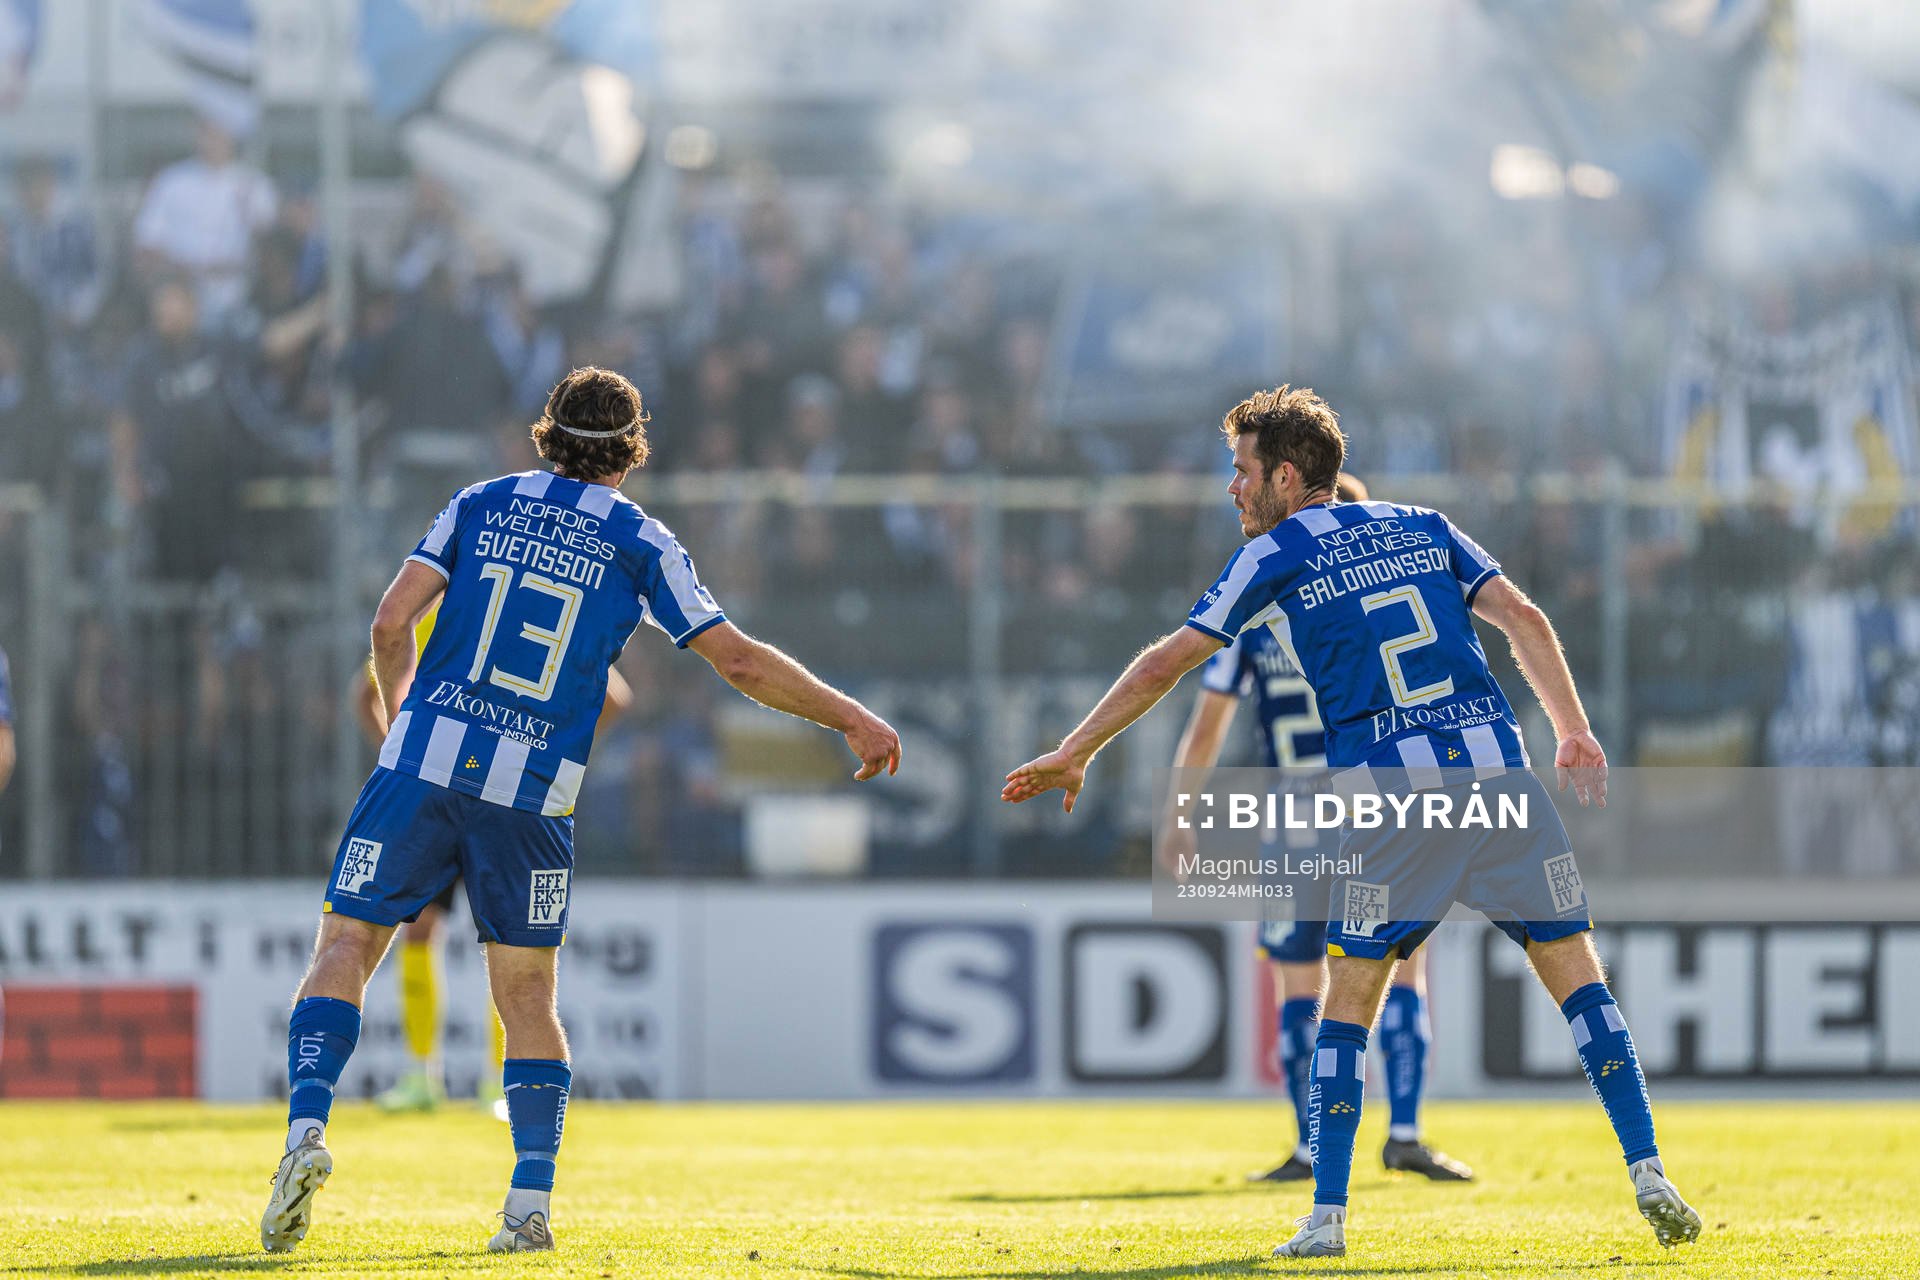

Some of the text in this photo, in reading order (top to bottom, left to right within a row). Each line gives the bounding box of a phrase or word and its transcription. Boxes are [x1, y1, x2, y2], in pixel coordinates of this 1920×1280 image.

[509, 498, 600, 535] NORDIC
[486, 510, 616, 561] WELLNESS
[1317, 520, 1403, 550] NORDIC
[475, 530, 605, 590] SVENSSON
[1305, 532, 1432, 572] WELLNESS
[1298, 548, 1450, 610] SALOMONSSON
[466, 561, 584, 702] 13
[1360, 584, 1455, 708] 2
[1459, 712, 1503, 727] INSTALCO
[503, 728, 548, 750] INSTALCO
[349, 841, 374, 859] EFF
[344, 856, 374, 876] EKT
[339, 871, 356, 887] IV
[534, 873, 564, 889] EFF
[1551, 871, 1580, 893] EKT
[533, 888, 565, 905] EKT
[1348, 884, 1381, 903] EFF
[1555, 888, 1573, 908] IV
[532, 904, 552, 920] IV
[1347, 900, 1385, 919] EKT
[1345, 915, 1366, 932] IV
[0, 908, 162, 970] LLT
[888, 926, 1285, 1080] SD
[1492, 928, 1920, 1074] THE
